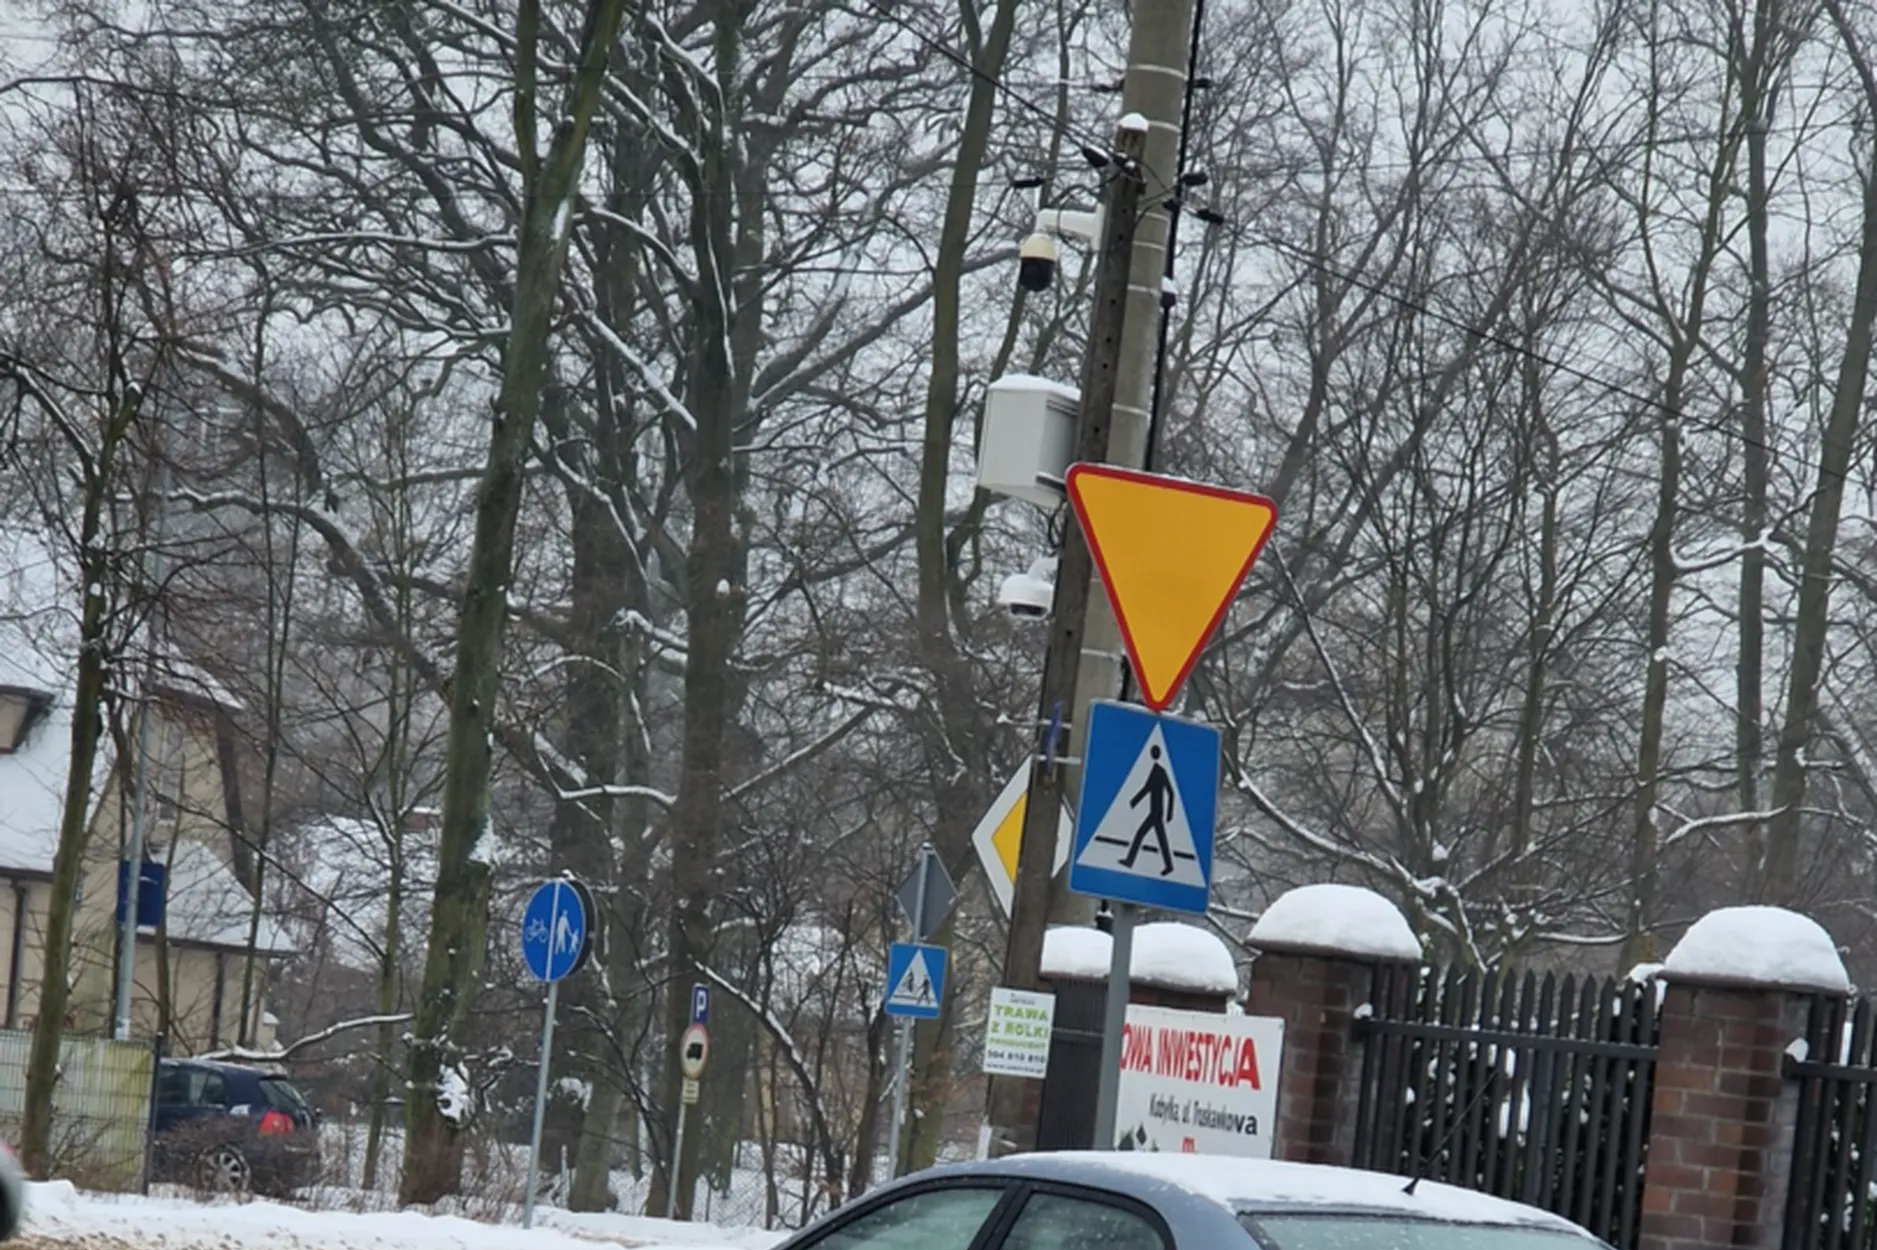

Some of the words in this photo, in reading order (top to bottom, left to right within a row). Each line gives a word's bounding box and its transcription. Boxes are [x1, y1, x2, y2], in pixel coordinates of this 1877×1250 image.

[696, 991, 706, 1018] P
[994, 1004, 1049, 1022] TRAWA
[991, 1021, 1000, 1033] Z
[1004, 1022, 1049, 1038] ROLKI
[1119, 1023, 1152, 1074] OWA
[1156, 1028, 1261, 1091] INWESTYCJA
